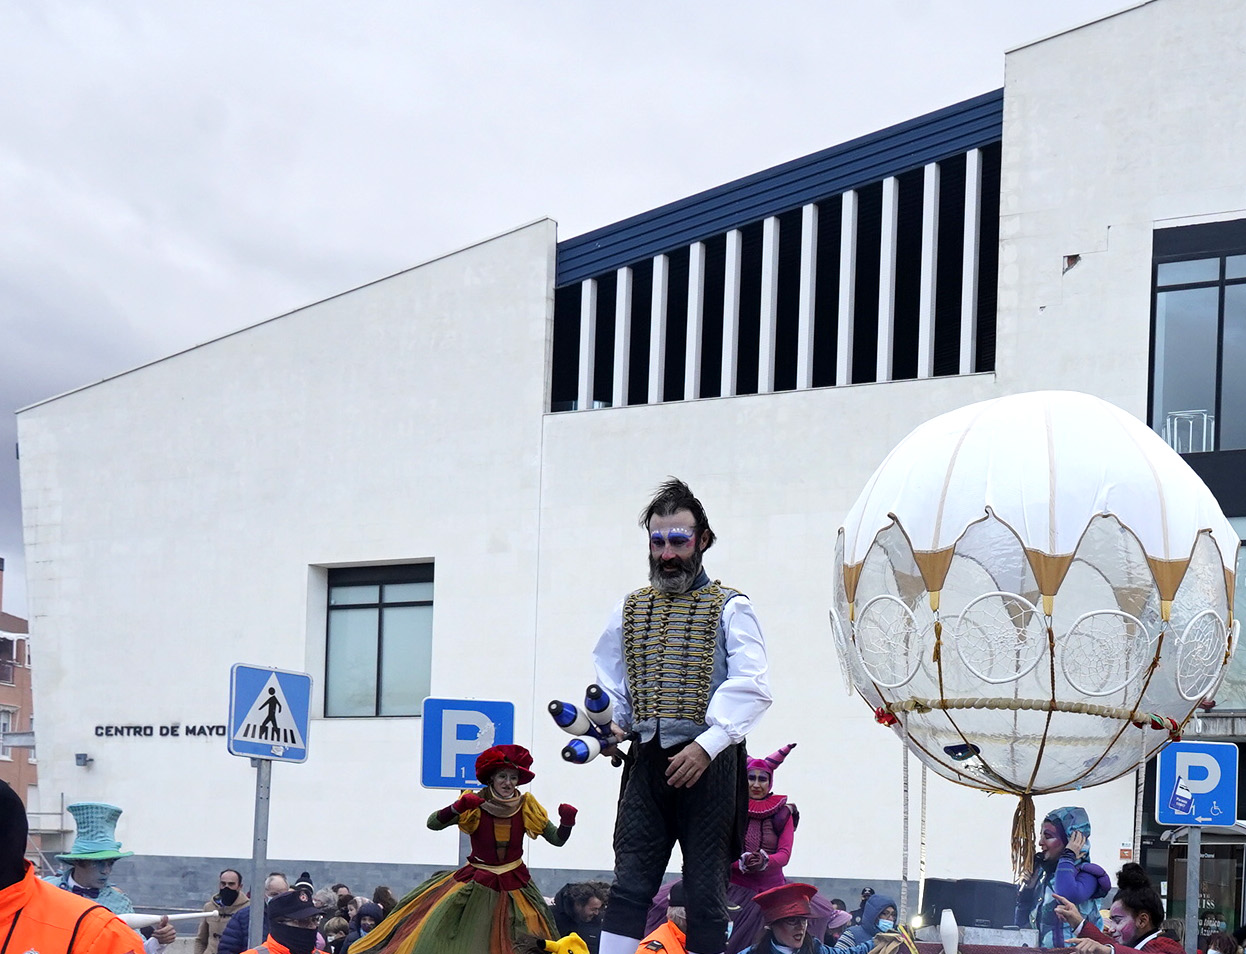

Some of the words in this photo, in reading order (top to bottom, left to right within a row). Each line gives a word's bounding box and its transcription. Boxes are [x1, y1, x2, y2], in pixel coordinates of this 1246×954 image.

[94, 725, 154, 738] CENTRO
[159, 725, 180, 737] DE
[441, 709, 495, 777] P
[1176, 752, 1222, 815] P
